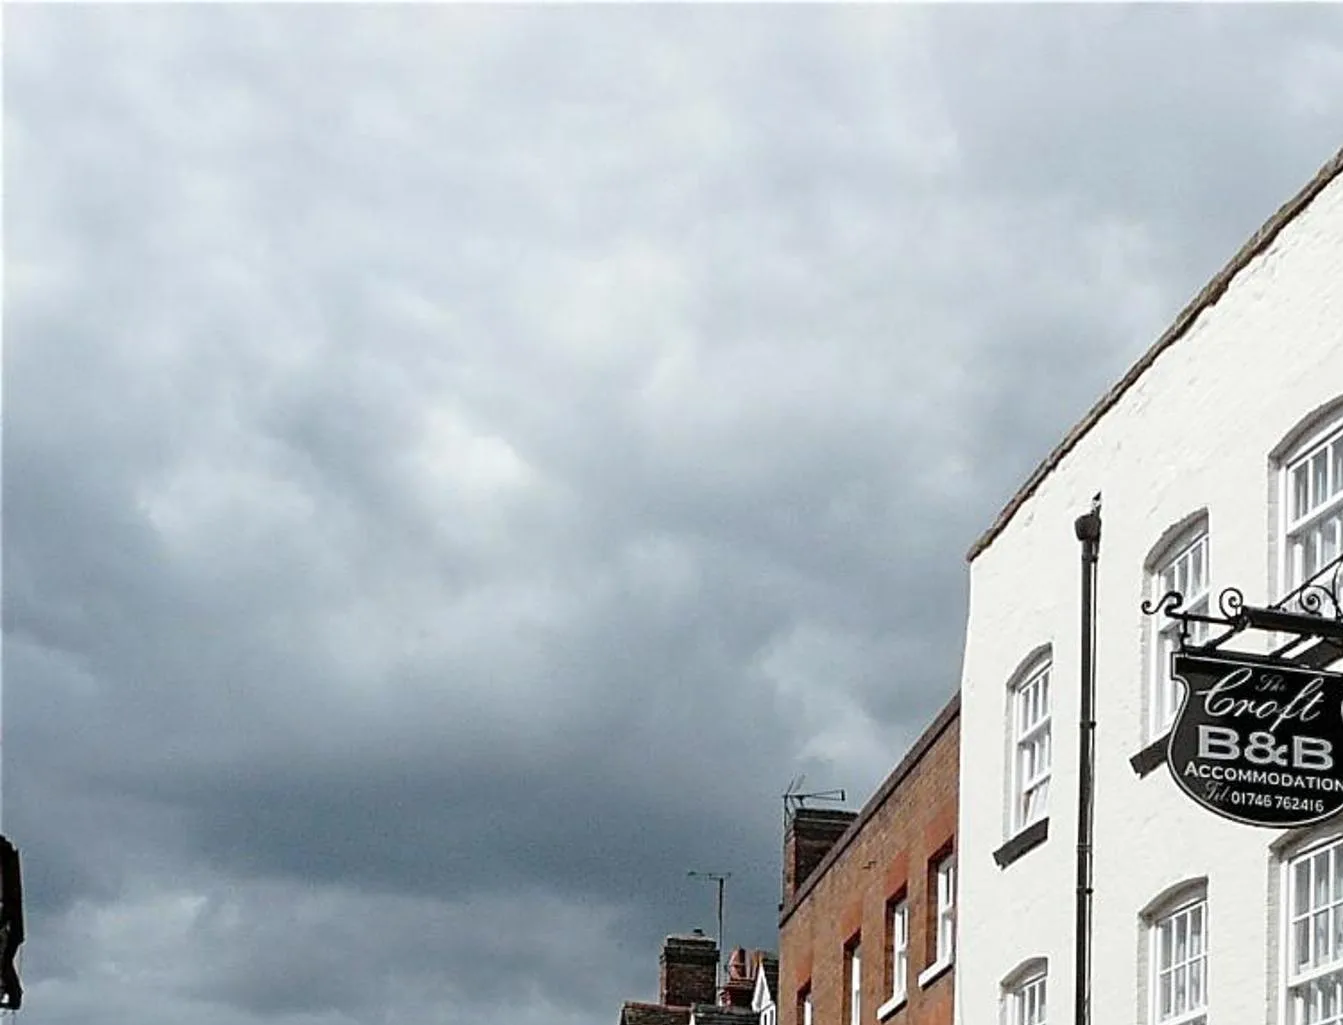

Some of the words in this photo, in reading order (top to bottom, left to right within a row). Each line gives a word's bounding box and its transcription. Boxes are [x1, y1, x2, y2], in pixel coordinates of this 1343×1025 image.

[1196, 667, 1325, 732] Croft
[1197, 724, 1334, 770] B&B
[1275, 796, 1324, 812] 762416
